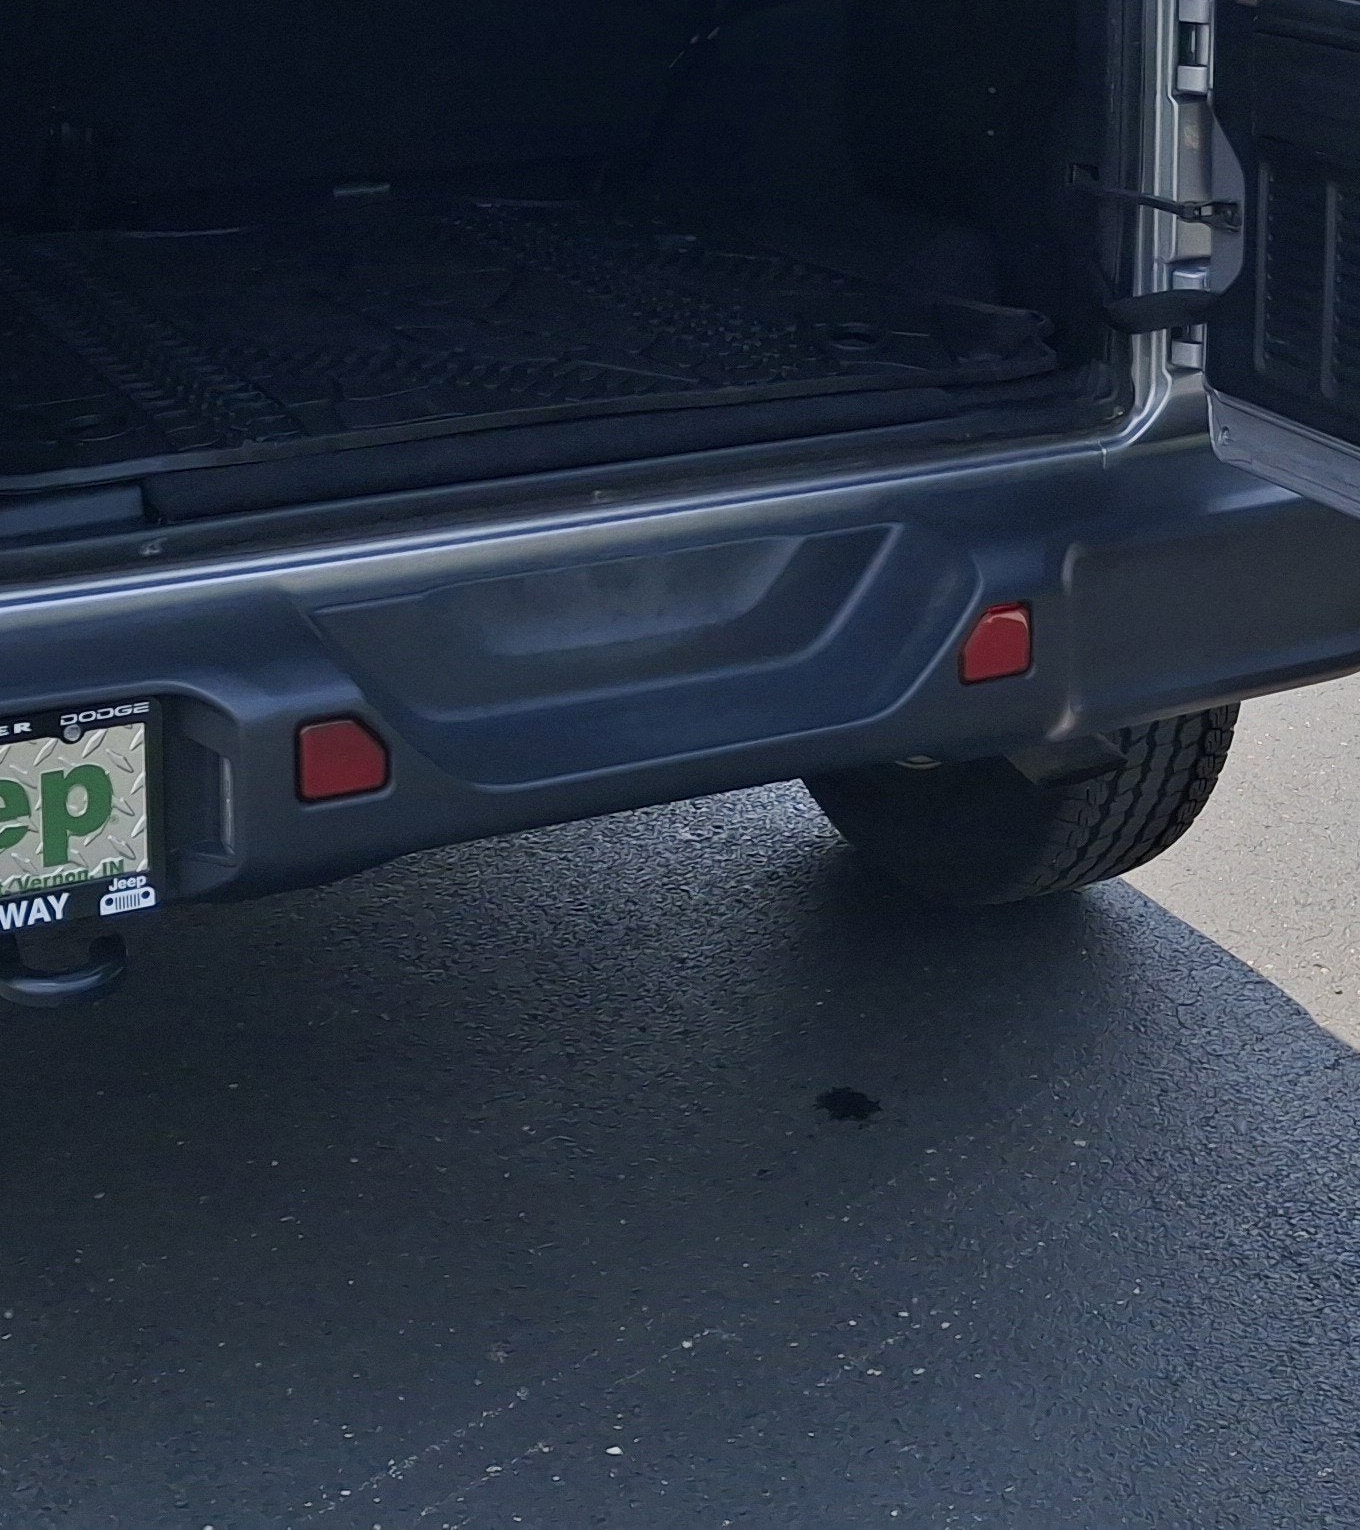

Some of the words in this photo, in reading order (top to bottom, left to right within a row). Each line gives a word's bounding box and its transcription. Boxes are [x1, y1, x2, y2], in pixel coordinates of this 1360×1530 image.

[60, 702, 150, 726] DODGE
[102, 858, 125, 876] IN
[108, 875, 148, 892] Jeep
